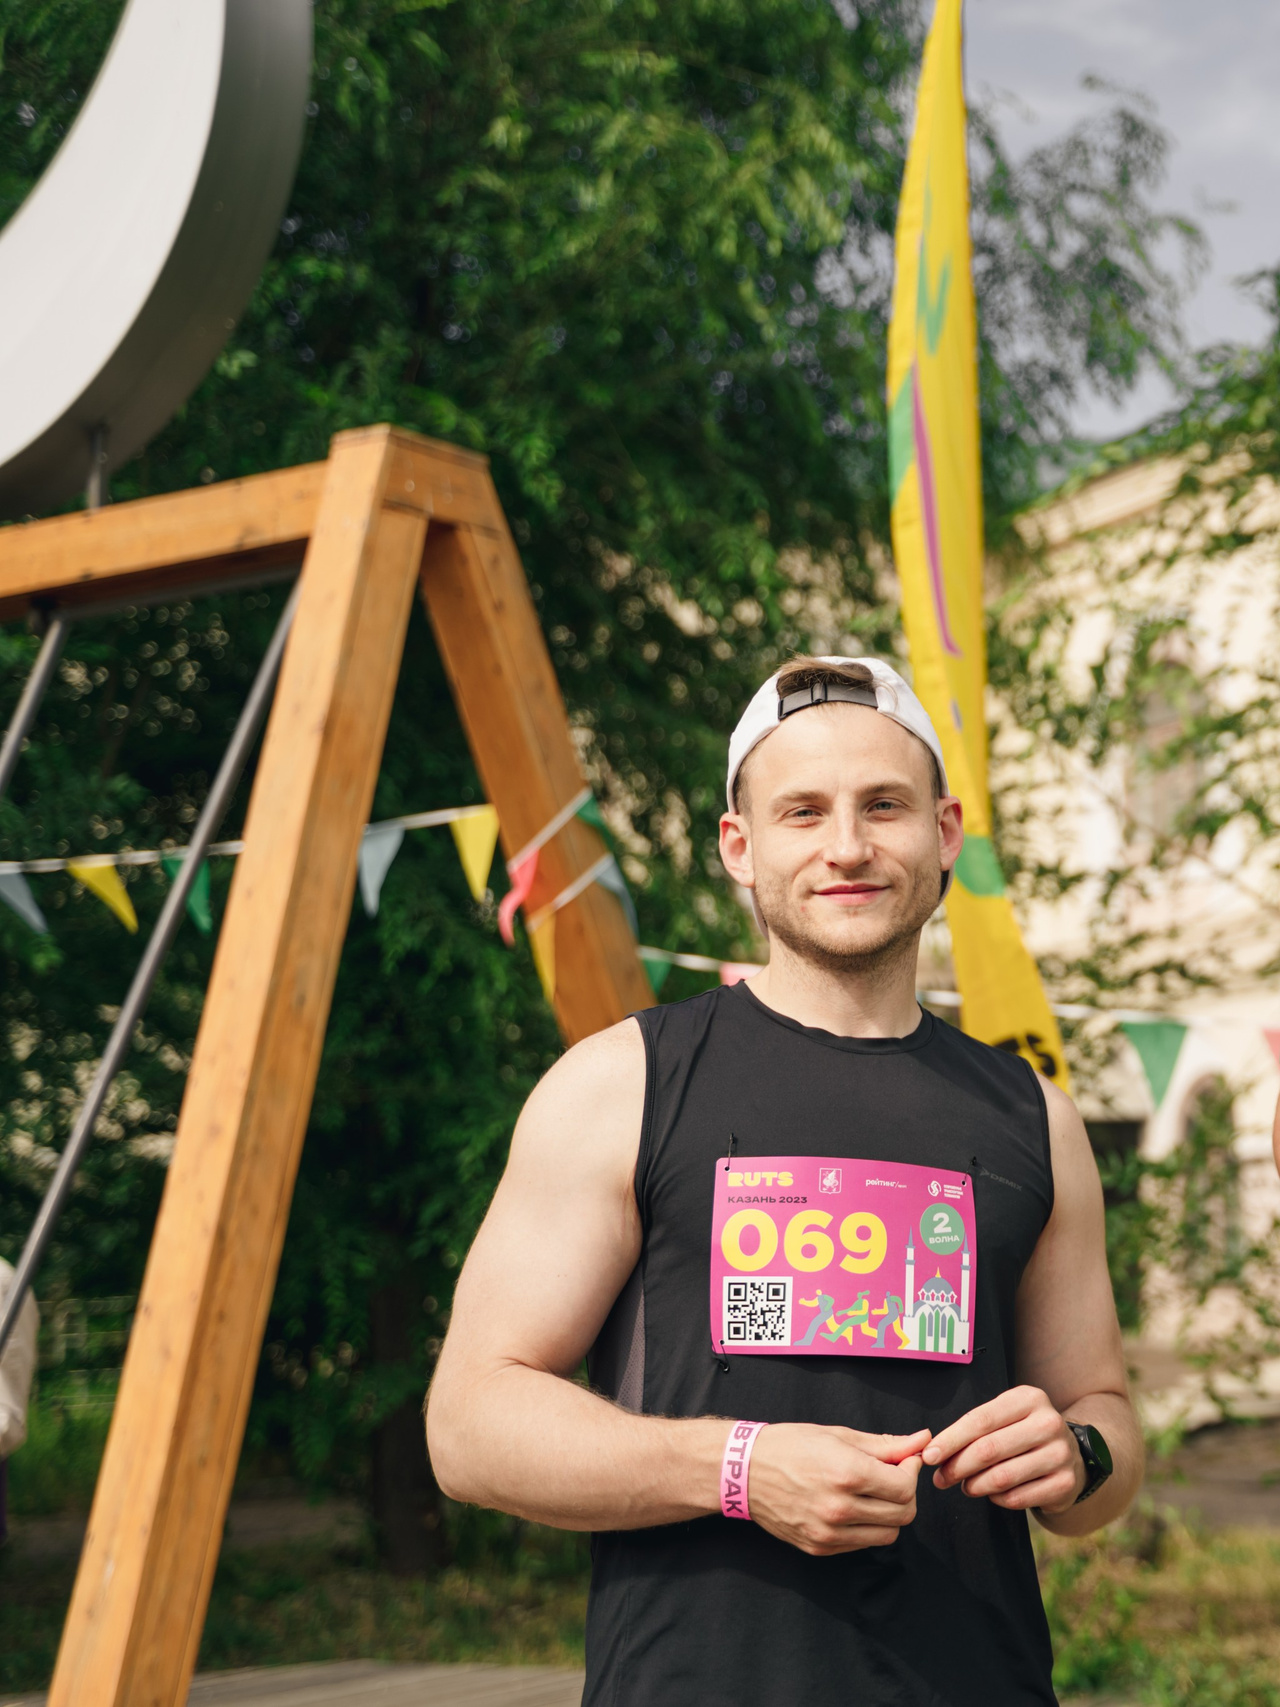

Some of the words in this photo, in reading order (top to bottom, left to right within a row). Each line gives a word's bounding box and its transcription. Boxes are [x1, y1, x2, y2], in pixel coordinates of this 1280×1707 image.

[727, 1171, 794, 1187] RUTS
[779, 1196, 808, 1204] 2023
[932, 1212, 952, 1234] 2
[721, 1208, 888, 1275] 069
[929, 1235, 960, 1244] ВОЛНА
